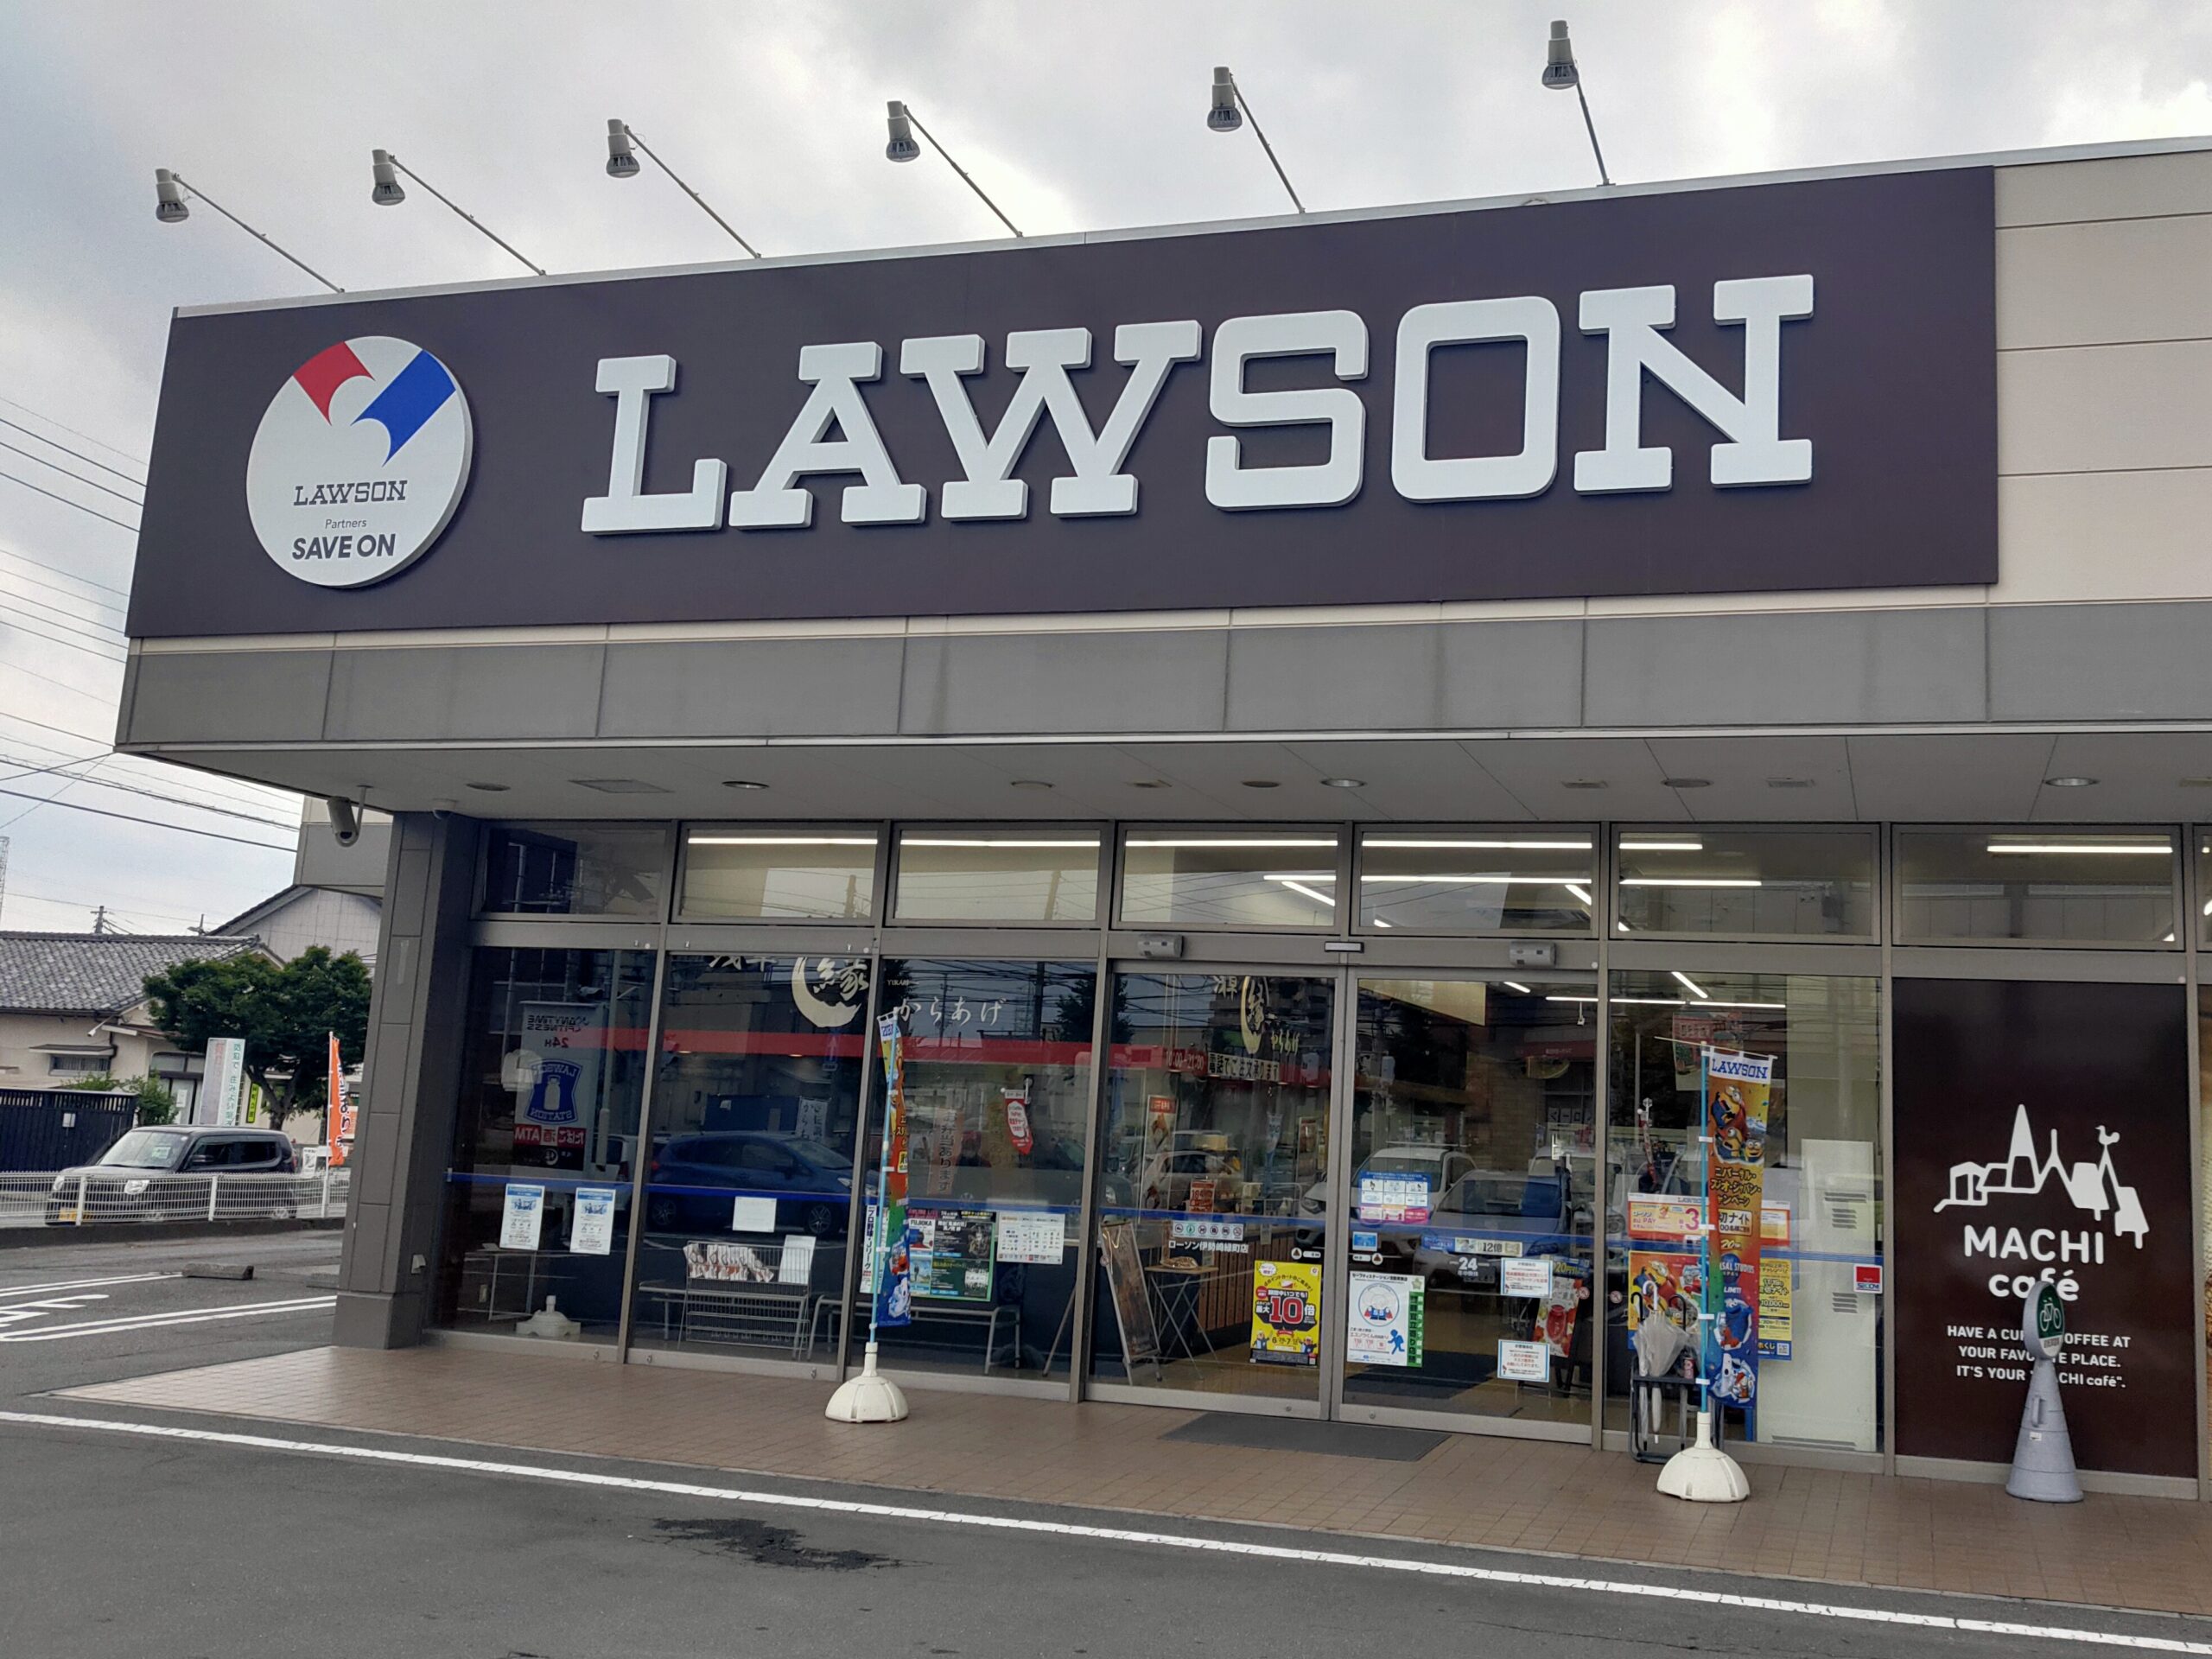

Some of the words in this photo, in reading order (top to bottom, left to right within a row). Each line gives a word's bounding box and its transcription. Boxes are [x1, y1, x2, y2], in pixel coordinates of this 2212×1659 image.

[582, 274, 1815, 536] LAWSON
[293, 480, 408, 506] LAWSON
[324, 518, 367, 530] Partners
[292, 535, 353, 560] SAVE
[356, 533, 397, 557] ON
[896, 995, 1007, 1027] からあげ
[1711, 1058, 1768, 1079] LAWSON
[1964, 1225, 2104, 1265] MACHI
[1458, 1256, 1478, 1271] 24
[1269, 1295, 1304, 1325] 10
[1947, 1325, 1985, 1340] HAVE
[1986, 1326, 1998, 1340] A
[2064, 1333, 2110, 1348] OFFEE
[2112, 1336, 2132, 1348] AT
[1958, 1345, 1997, 1360] YOUR
[2070, 1351, 2121, 1368] PLACE.
[1956, 1364, 1984, 1378] IT'S
[1986, 1366, 2026, 1382] YOUR
